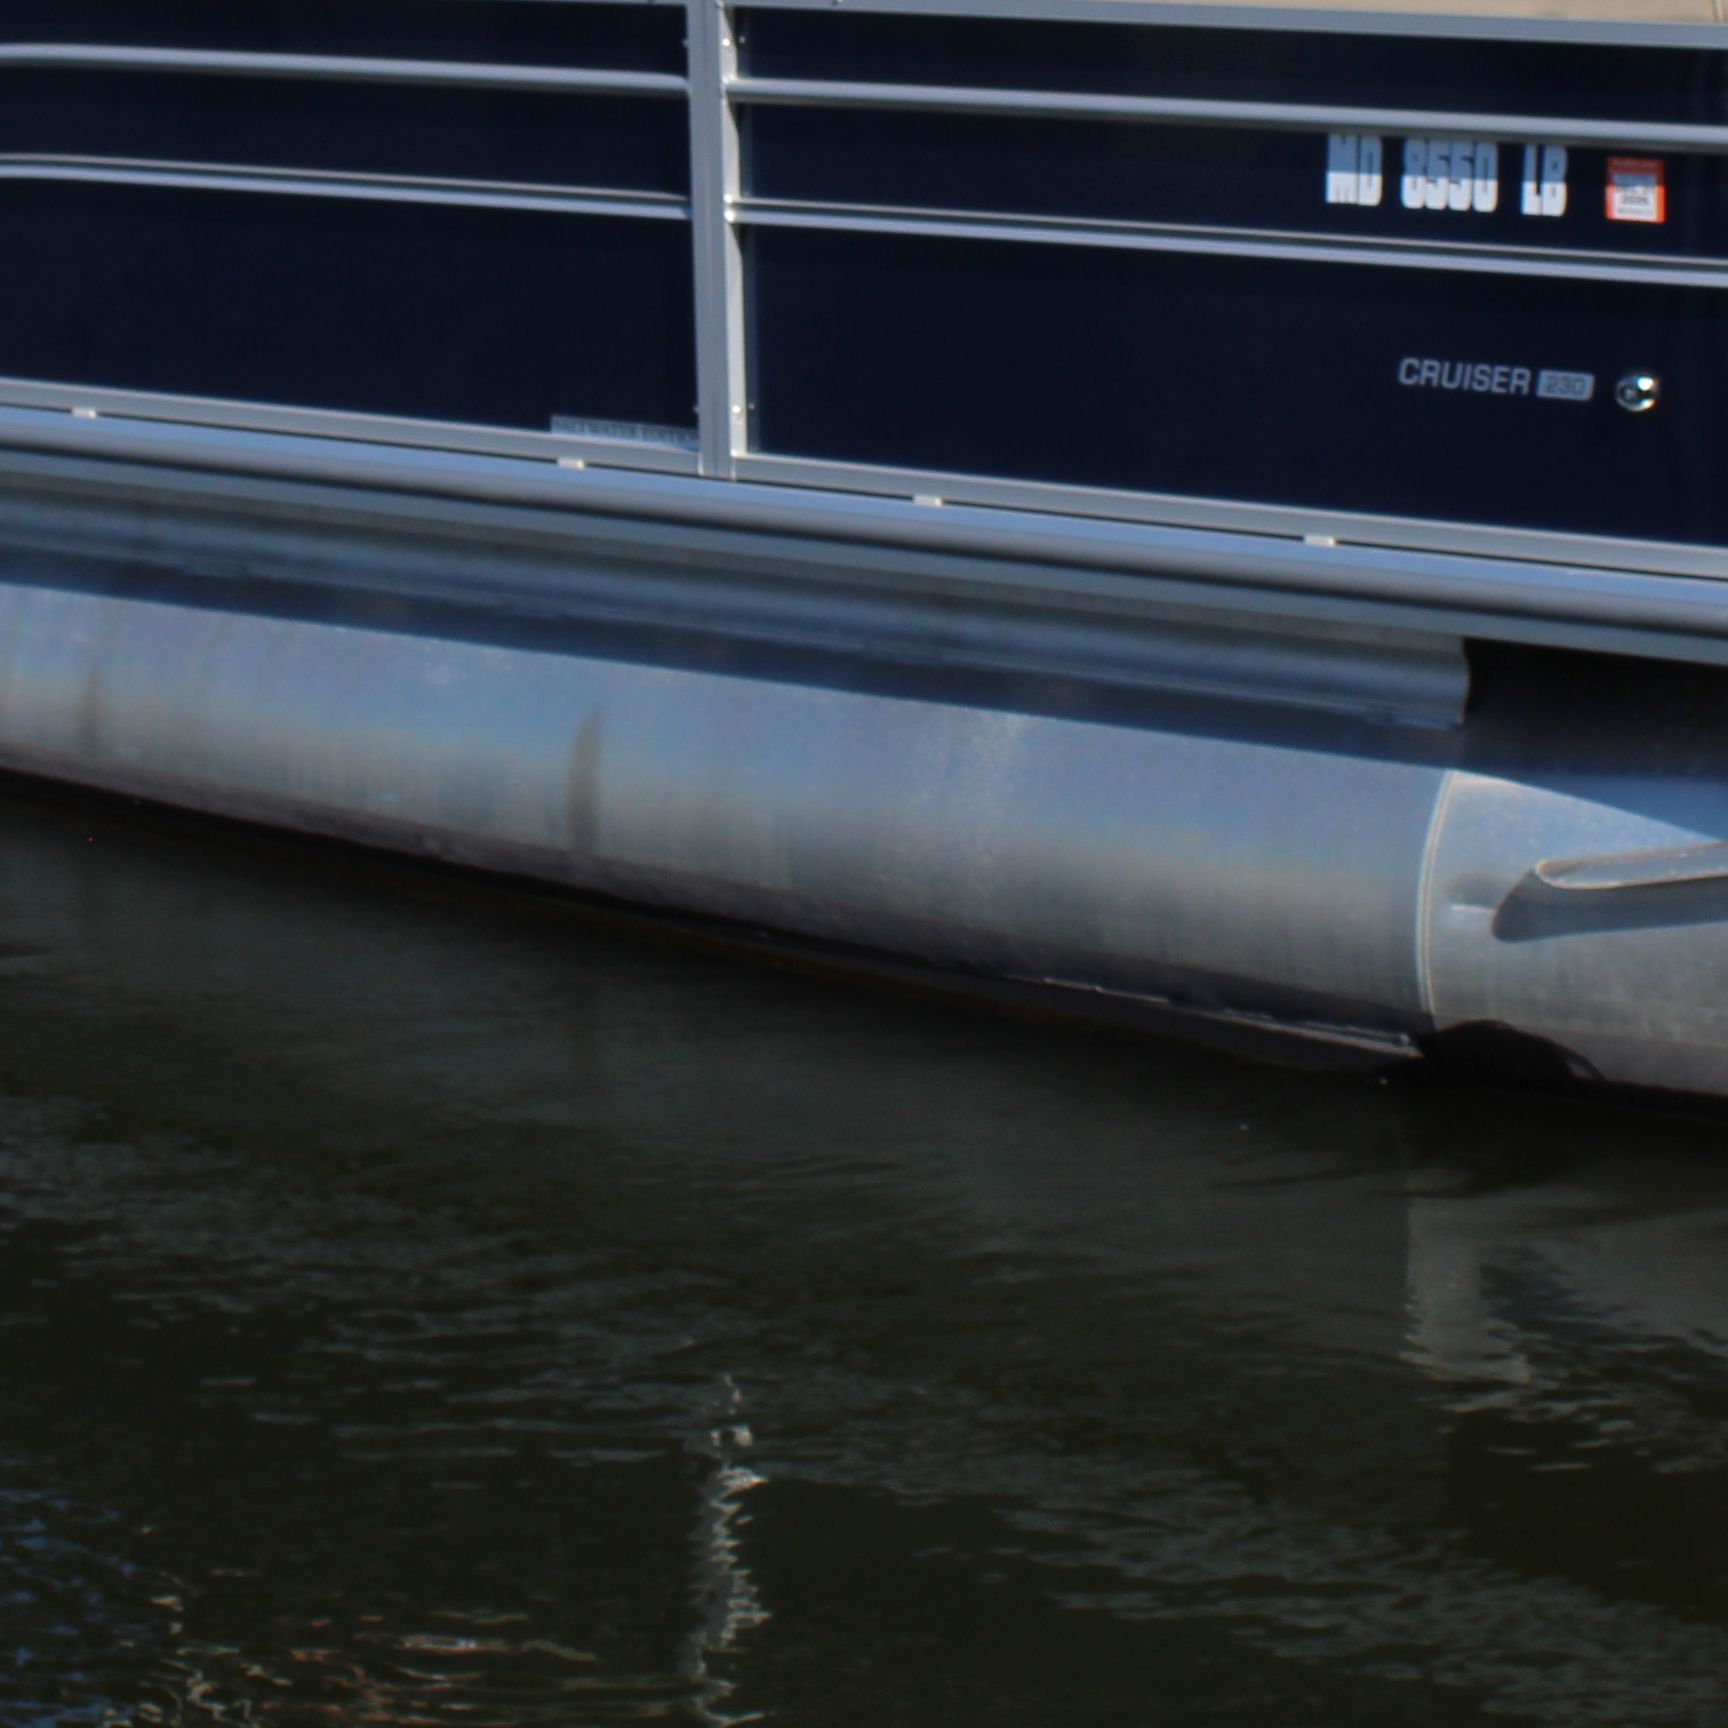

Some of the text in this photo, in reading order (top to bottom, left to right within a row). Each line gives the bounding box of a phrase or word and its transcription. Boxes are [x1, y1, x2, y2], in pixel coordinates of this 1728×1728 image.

[1325, 133, 1384, 207] MD
[1520, 143, 1569, 218] LB
[1398, 357, 1589, 398] CRUISER 230
